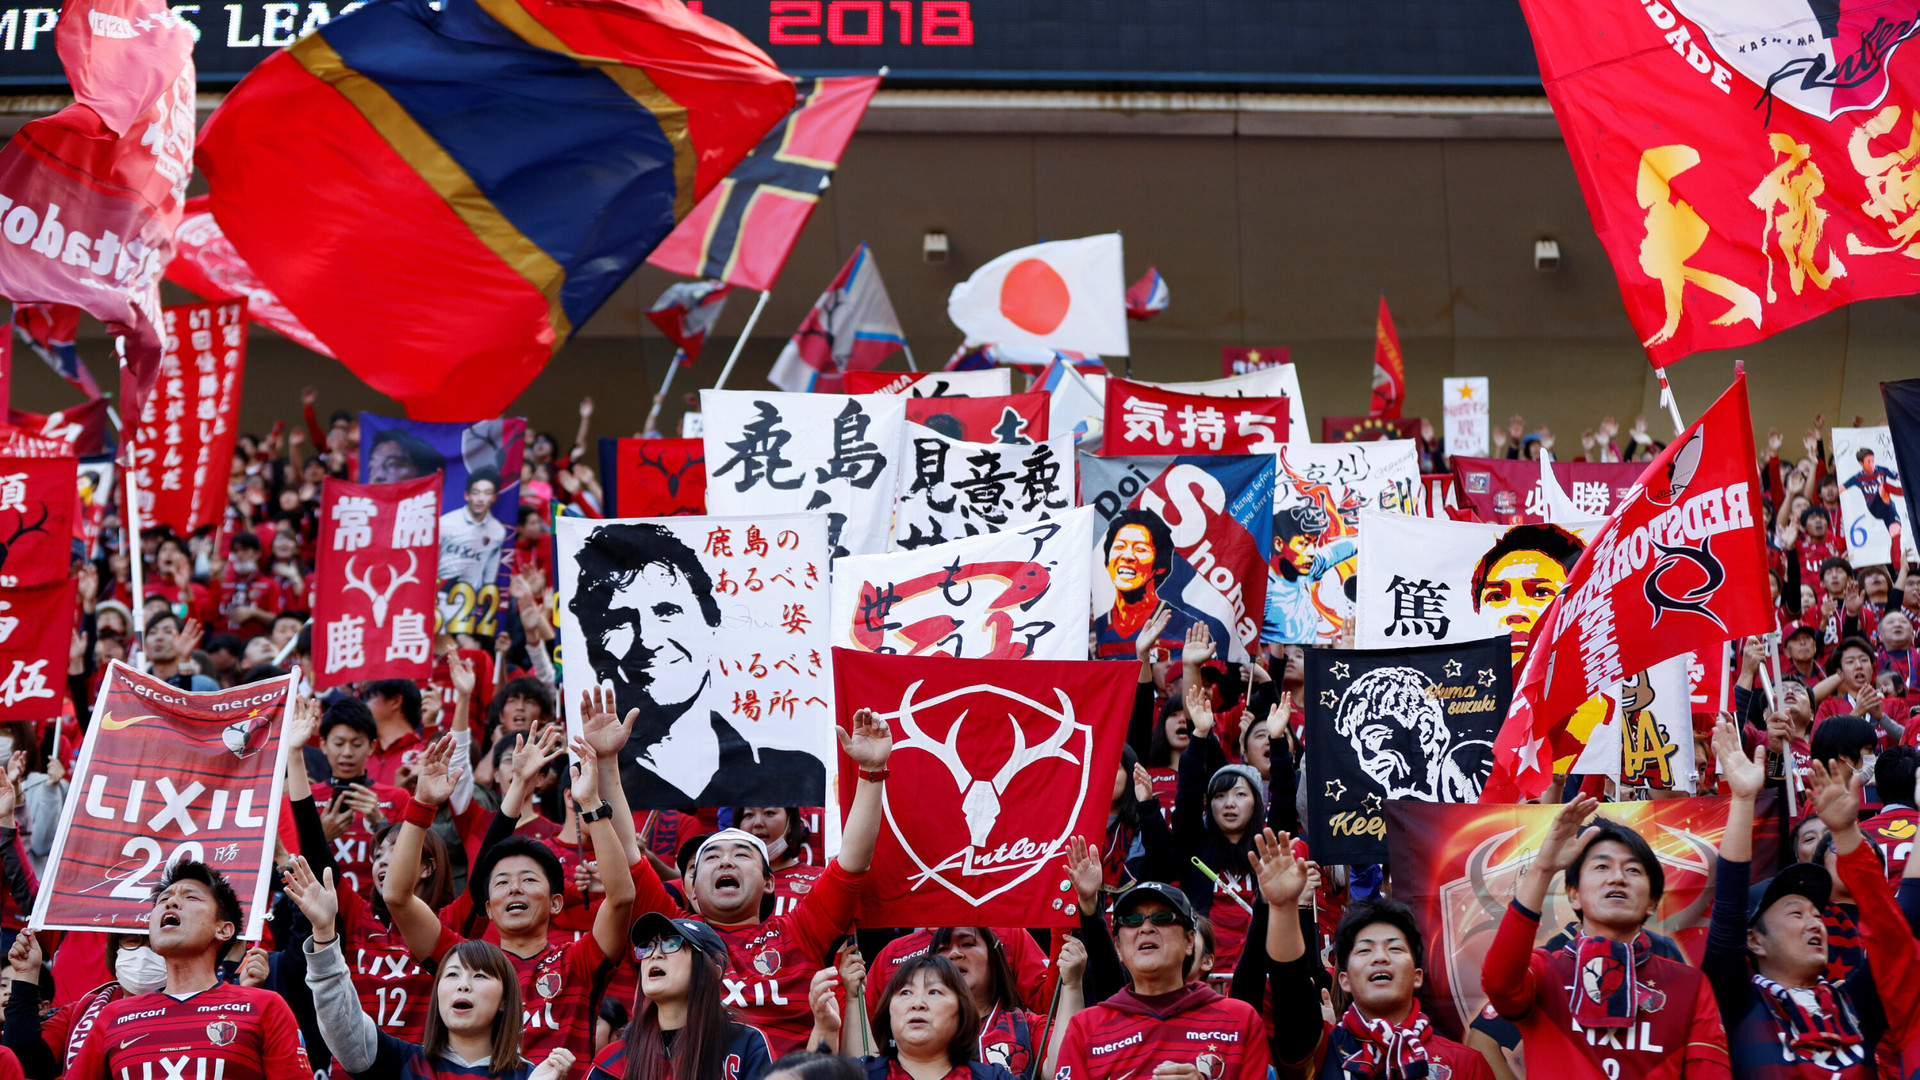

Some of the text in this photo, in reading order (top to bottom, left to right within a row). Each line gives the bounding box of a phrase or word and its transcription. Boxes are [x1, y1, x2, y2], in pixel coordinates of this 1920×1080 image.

[769, 0, 973, 45] 2018
[1642, 0, 1733, 95] DADE
[1738, 33, 1815, 54] KASHIMA
[1123, 396, 1276, 451] 気持ち
[712, 398, 888, 493] 鹿島
[1093, 463, 1151, 522] Doi
[1229, 490, 1254, 517] Change
[332, 490, 437, 552] 常勝
[1850, 514, 1868, 548] 6
[704, 525, 799, 558] 鹿島の
[715, 562, 819, 596] あるべき
[780, 602, 812, 634] 姿
[1384, 574, 1451, 640] 篤
[325, 608, 431, 674] 鹿島
[719, 648, 823, 678] いるべき
[120, 675, 287, 712] mercari mercari
[732, 688, 828, 722] 場所へ
[85, 775, 265, 836] LIXIL
[375, 987, 408, 1027] 12
[721, 978, 789, 1008] XIL
[117, 1002, 251, 1025] mercari mercari
[1092, 1030, 1239, 1055] mercari mercari
